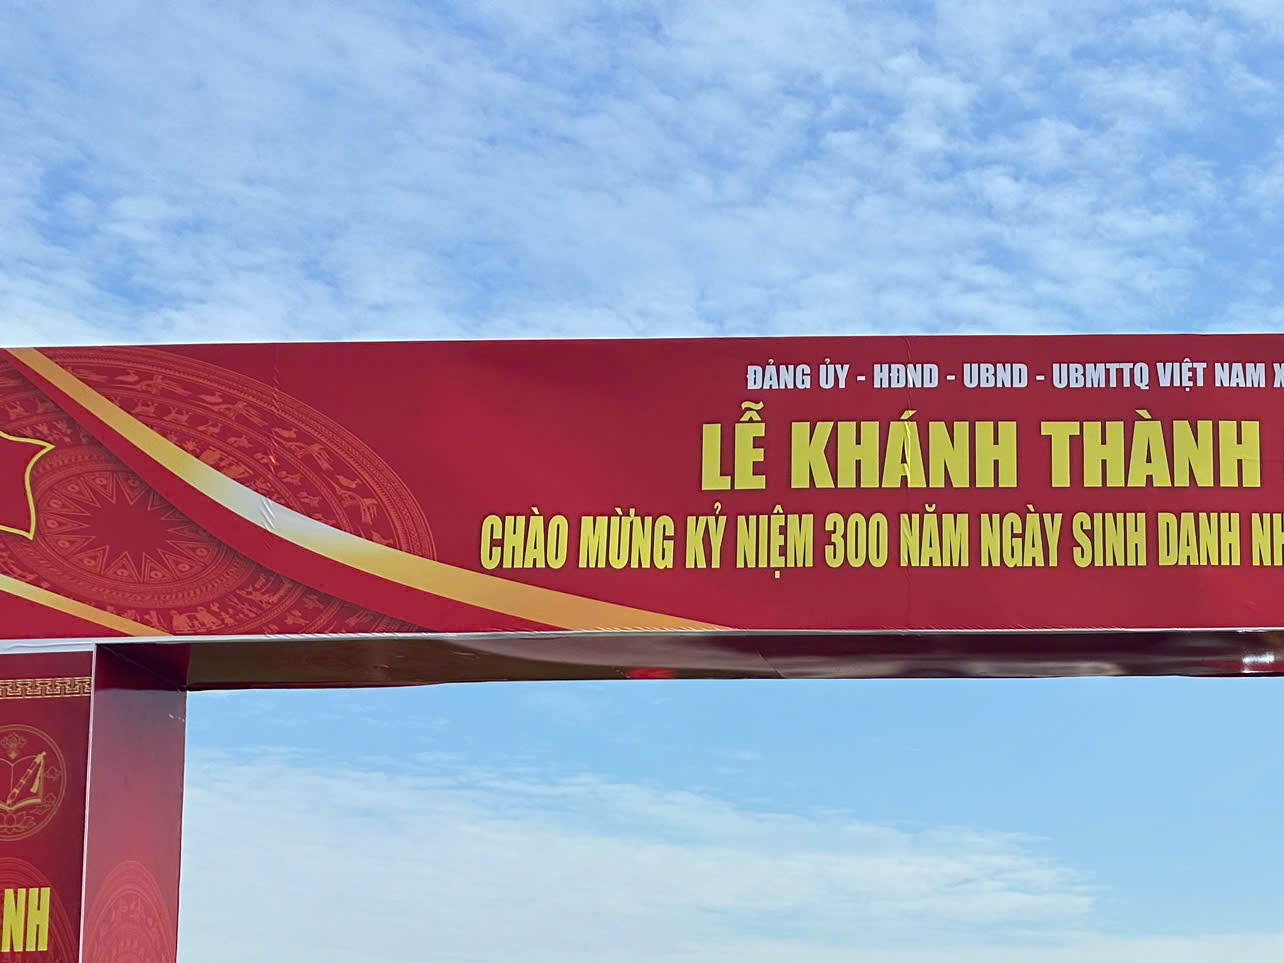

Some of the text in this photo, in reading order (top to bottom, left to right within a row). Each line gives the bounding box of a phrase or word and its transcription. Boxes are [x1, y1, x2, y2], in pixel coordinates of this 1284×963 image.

[747, 359, 810, 389] ĐẢNG
[820, 358, 849, 389] ỦY
[874, 364, 938, 388] HĐND
[964, 364, 1027, 388] UBND
[1053, 363, 1149, 389] UBMTTQ
[1156, 358, 1206, 391] VIỆT
[1215, 363, 1265, 387] NAM
[702, 401, 765, 490] LỄ
[791, 410, 1017, 488] KHÁNH
[1041, 410, 1260, 487] THÀNH
[480, 507, 568, 569] CHÀO
[579, 508, 674, 569] MỪNG
[686, 502, 726, 568] KỶ
[737, 505, 813, 578] NIỆM
[825, 513, 888, 567] 300
[901, 504, 968, 566] NĂM
[981, 505, 1062, 567] NGÀY
[1073, 512, 1146, 567] SINH
[1158, 513, 1240, 565] DANH
[0, 888, 50, 952] NH
